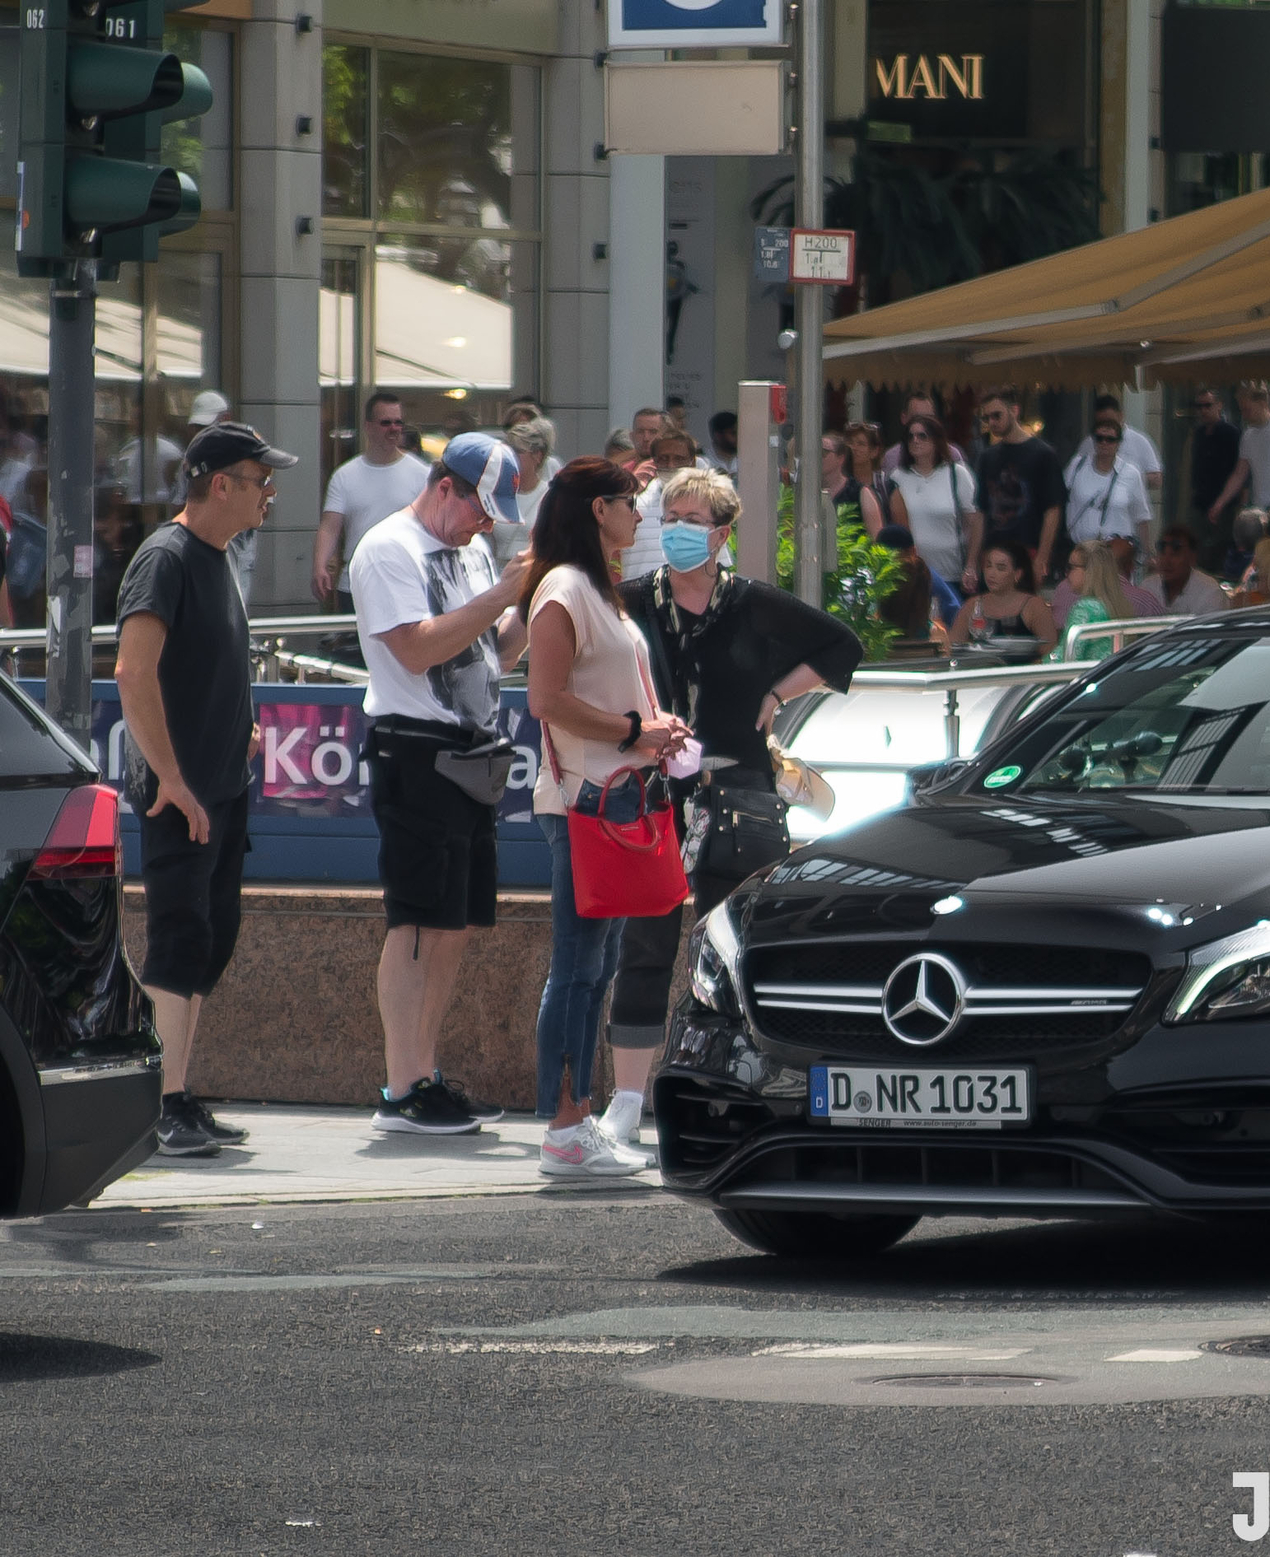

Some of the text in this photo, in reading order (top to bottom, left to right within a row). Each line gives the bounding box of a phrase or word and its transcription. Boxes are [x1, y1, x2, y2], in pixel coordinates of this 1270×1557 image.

[26, 9, 44, 28] 062
[876, 54, 985, 99] MANI
[804, 237, 837, 248] H200
[830, 1072, 1022, 1114] D NR 1031
[815, 1097, 822, 1109] D
